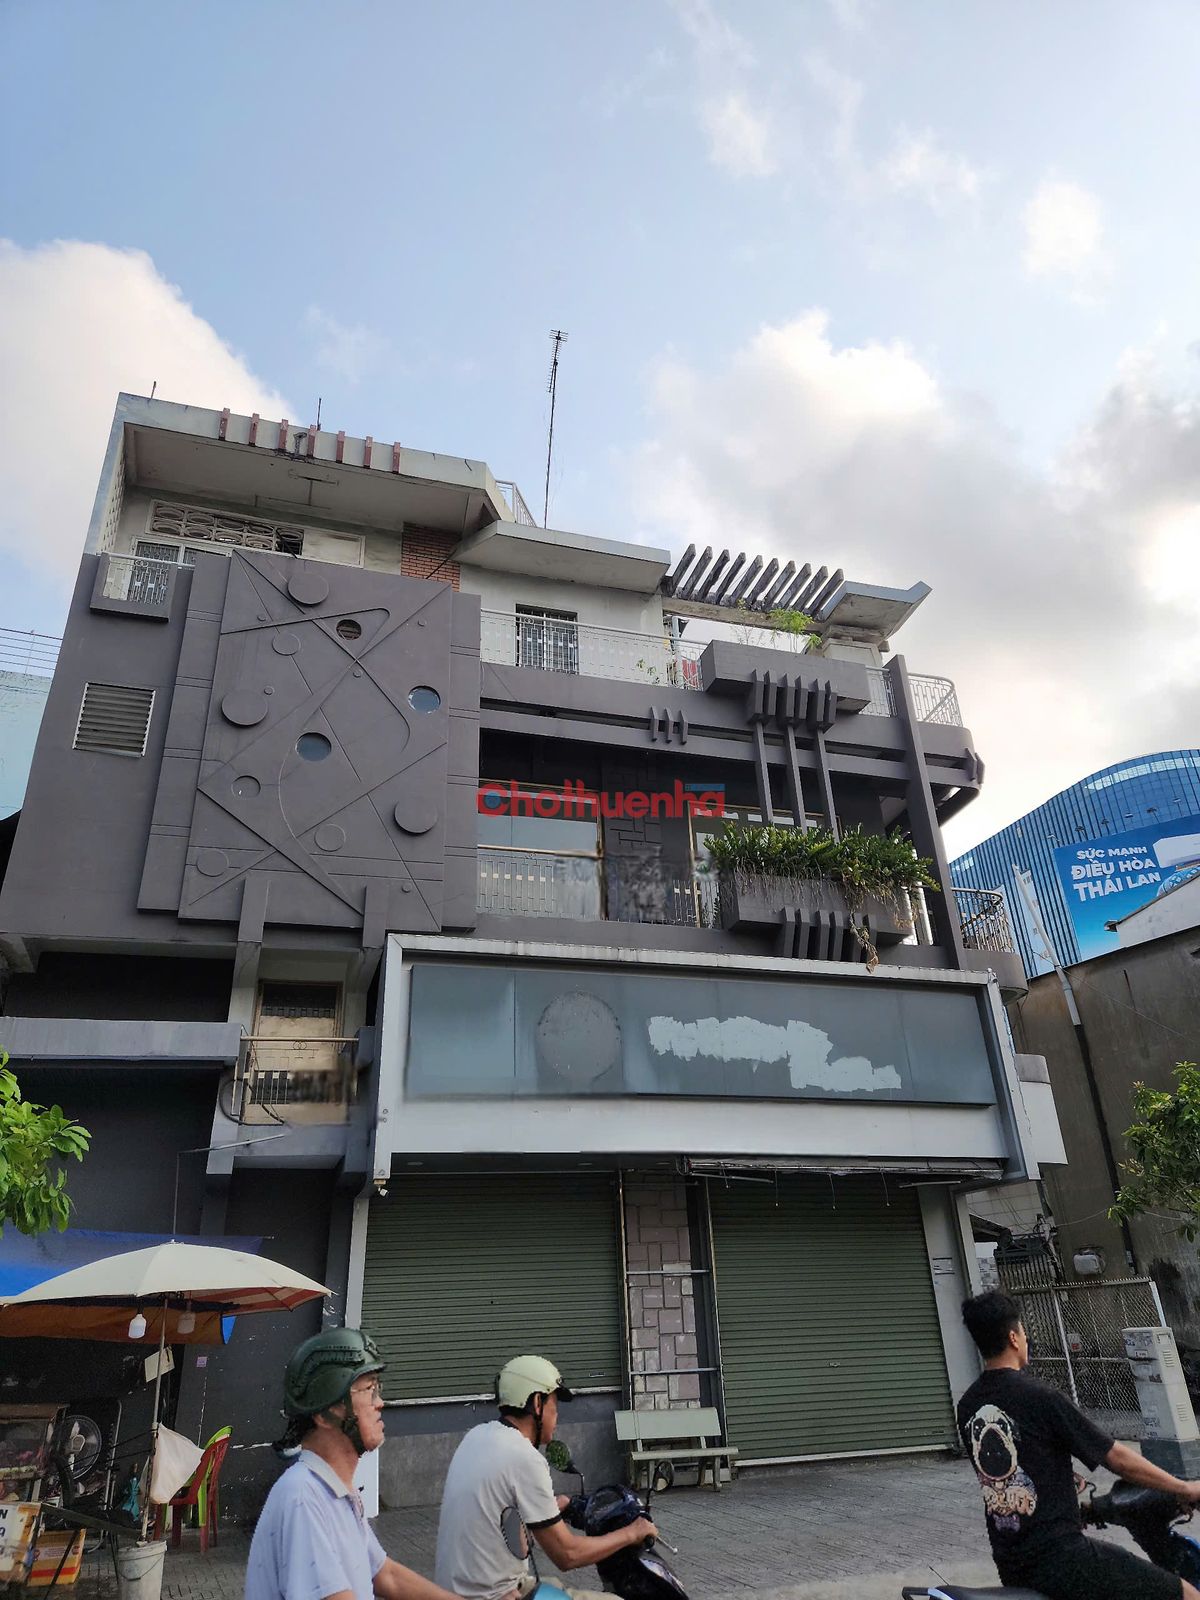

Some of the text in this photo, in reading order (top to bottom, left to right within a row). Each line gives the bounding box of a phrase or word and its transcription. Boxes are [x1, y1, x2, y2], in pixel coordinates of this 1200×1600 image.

[1076, 846, 1148, 860] SỨC MẠNH
[1071, 857, 1156, 880] ĐIỀU HÒA
[1073, 872, 1161, 901] THÁI LAN
